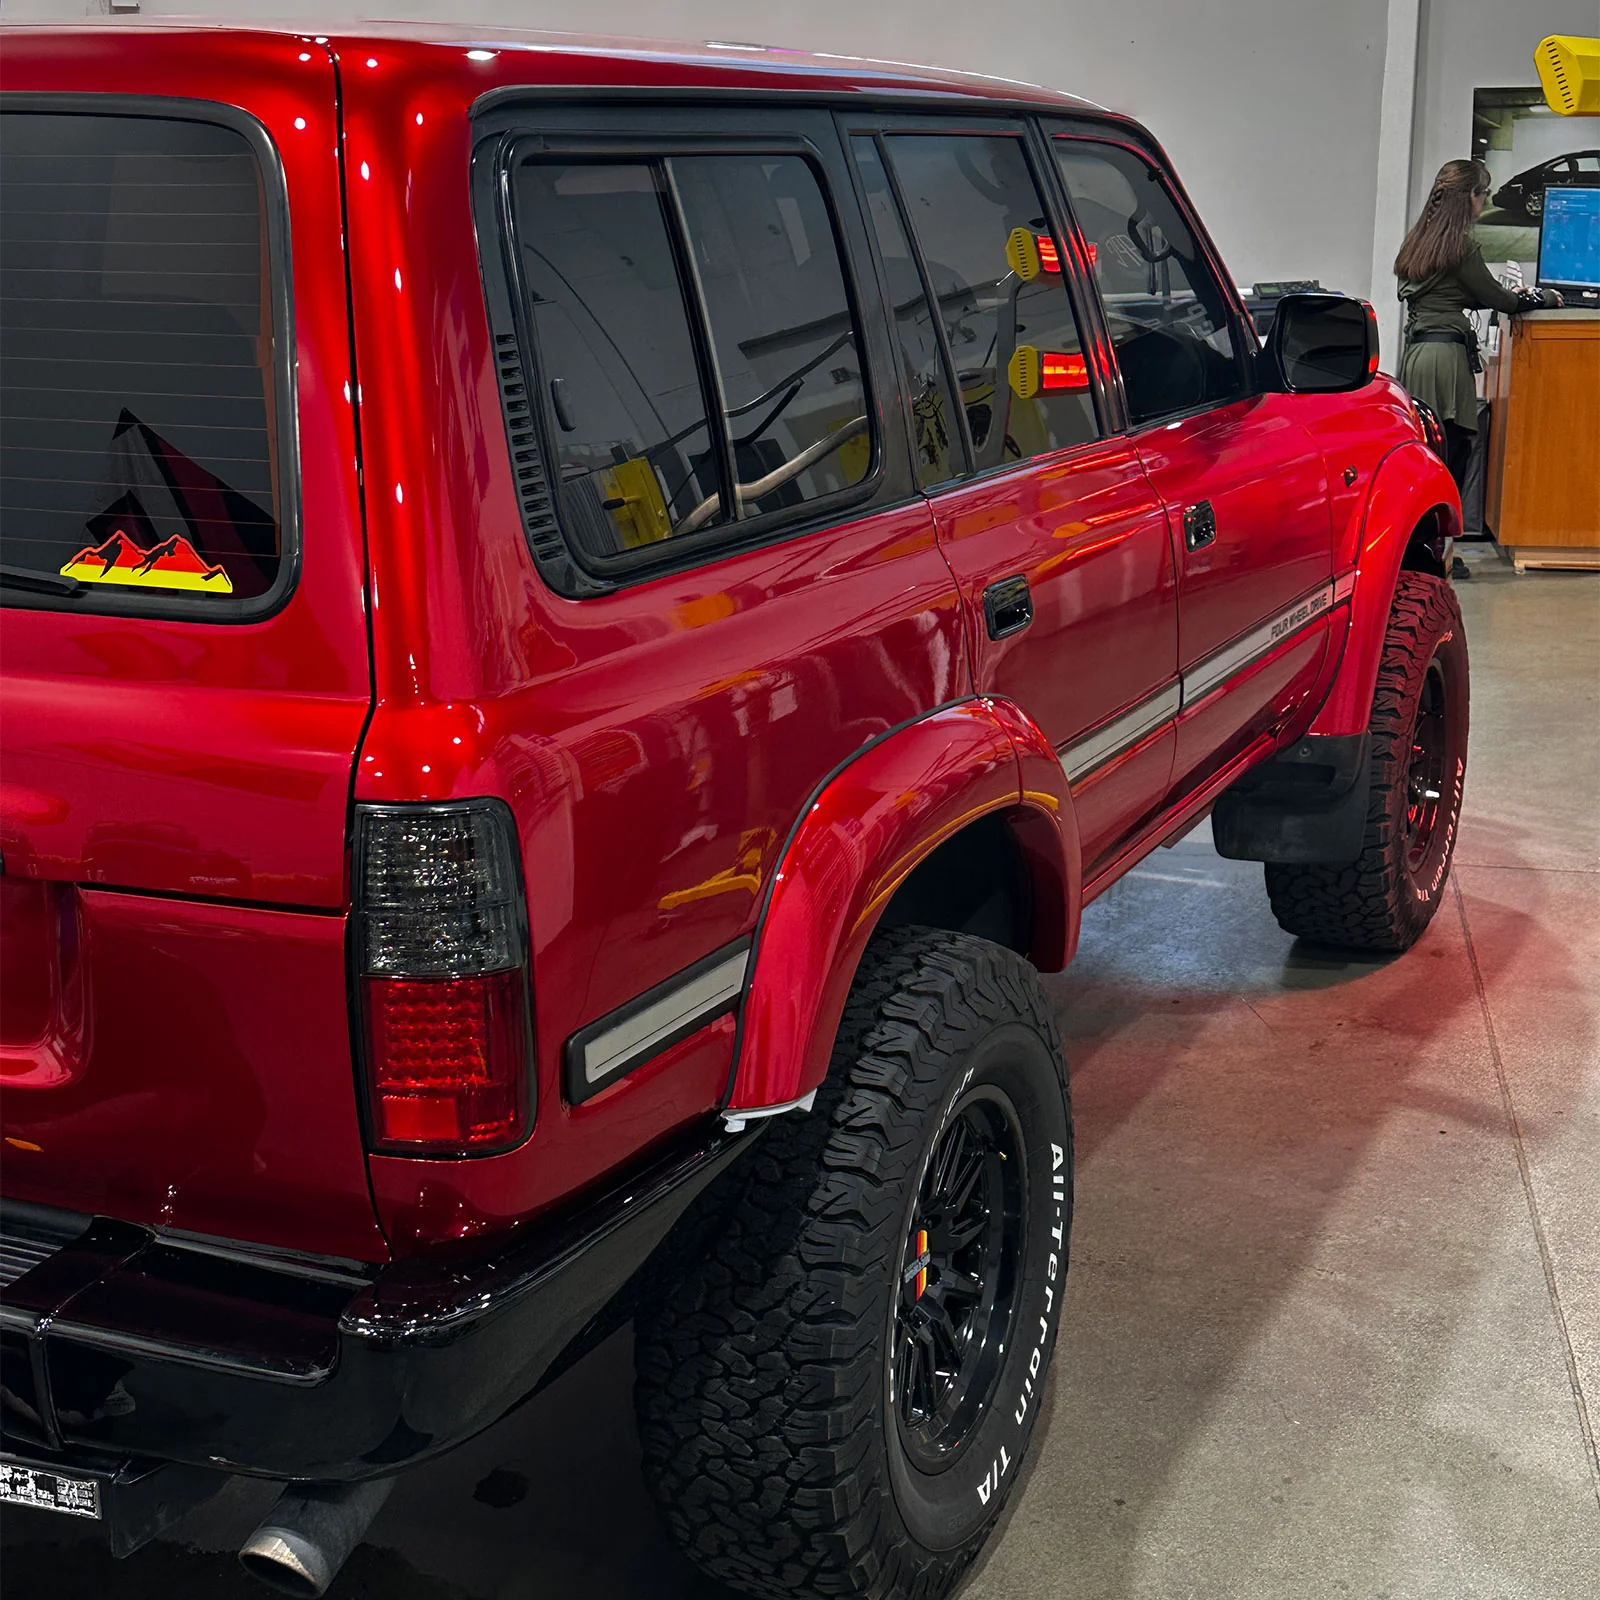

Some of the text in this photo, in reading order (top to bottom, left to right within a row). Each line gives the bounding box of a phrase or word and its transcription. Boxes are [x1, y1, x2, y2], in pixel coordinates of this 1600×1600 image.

[1270, 592, 1327, 641] FOUR WHEEL DRIVE
[976, 1142, 1065, 1505] All-Terrain T/A
